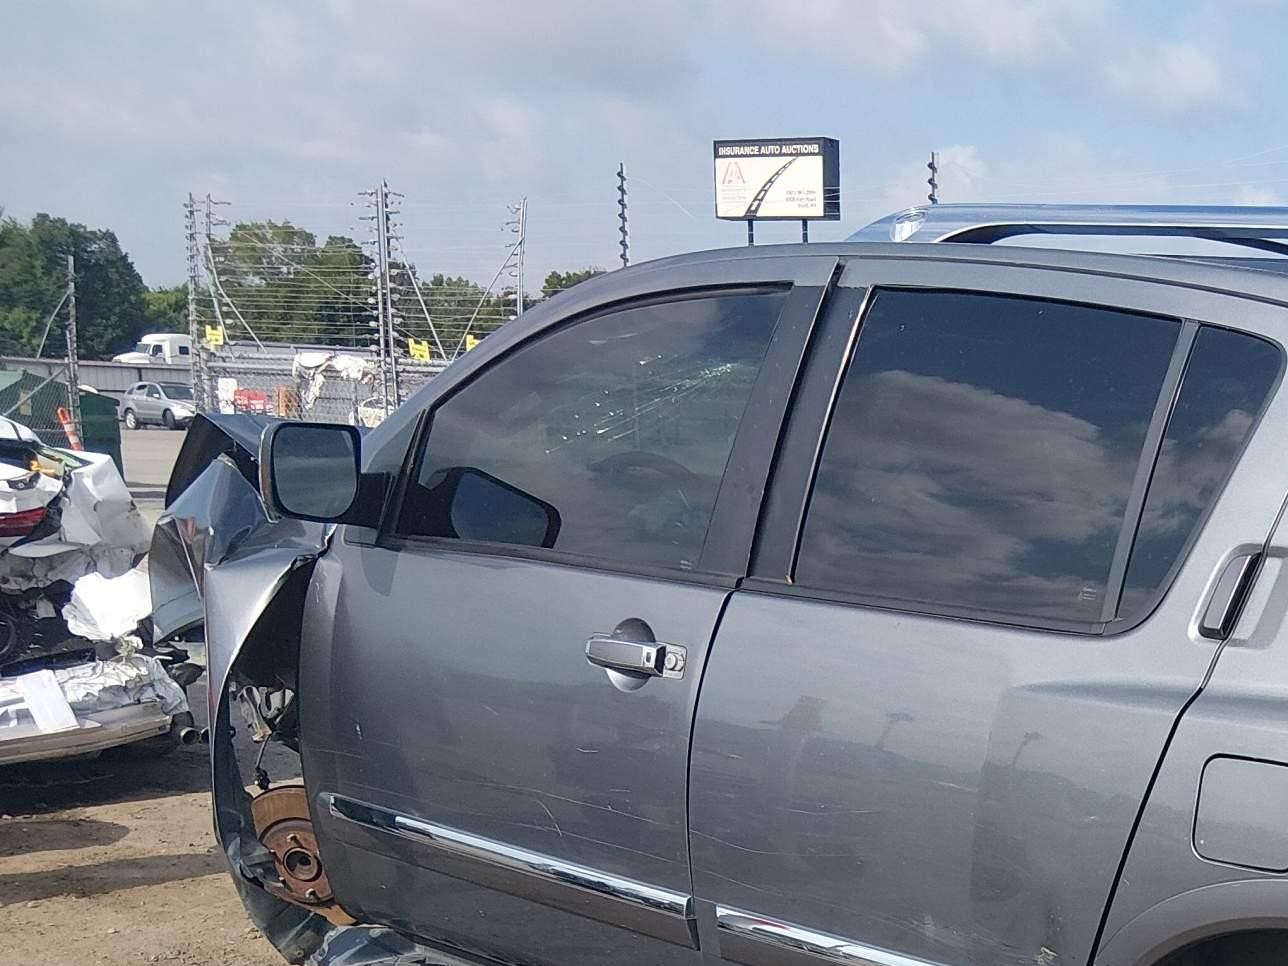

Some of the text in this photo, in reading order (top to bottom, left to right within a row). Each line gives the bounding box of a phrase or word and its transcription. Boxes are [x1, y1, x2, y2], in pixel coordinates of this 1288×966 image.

[718, 144, 819, 156] INSURANCE AUTO AUCTIONS
